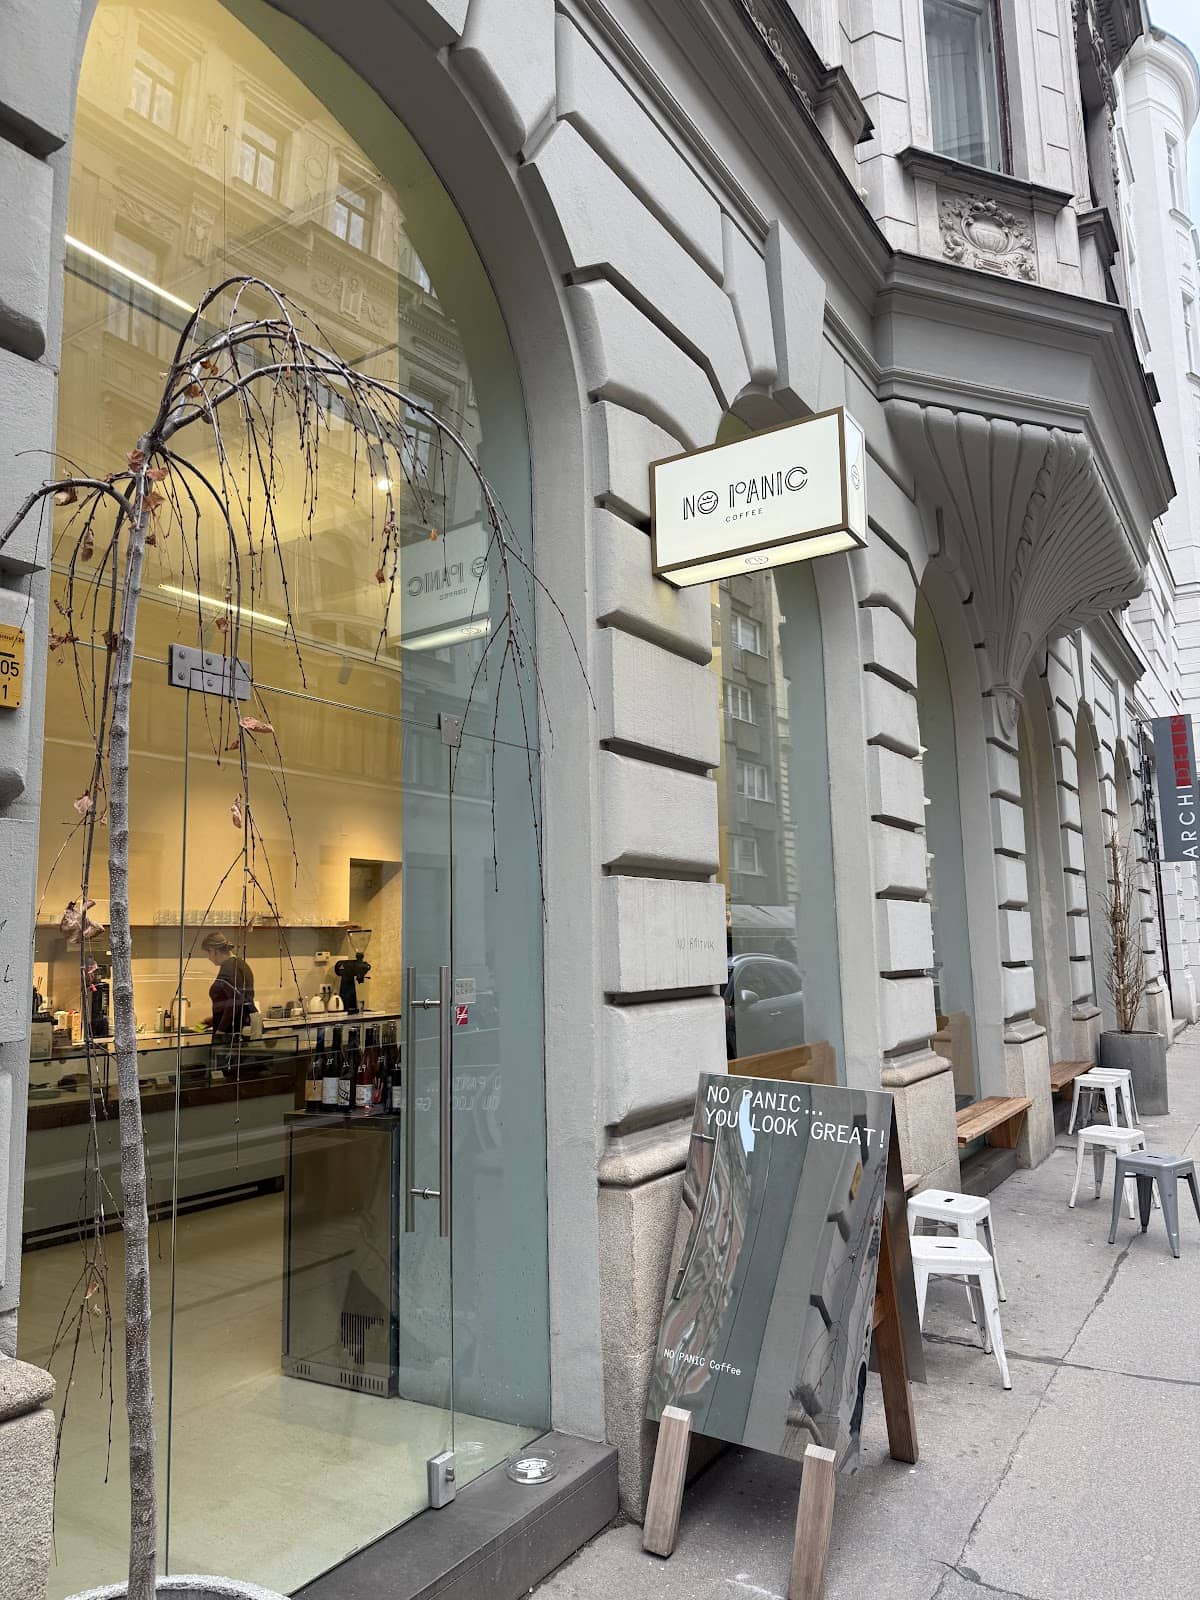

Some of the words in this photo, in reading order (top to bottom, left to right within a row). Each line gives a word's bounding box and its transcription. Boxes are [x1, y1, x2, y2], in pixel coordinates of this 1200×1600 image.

[683, 490, 718, 520] NO
[729, 466, 808, 509] PANIC
[725, 507, 763, 523] COFFEE
[707, 1085, 730, 1104] NO
[705, 1108, 739, 1128] YOU
[751, 1114, 799, 1137] LOOK
[810, 1121, 886, 1148] GREAT!
[663, 1348, 675, 1360] NO
[678, 1352, 706, 1367] PANIC
[709, 1359, 742, 1376] Coffee
